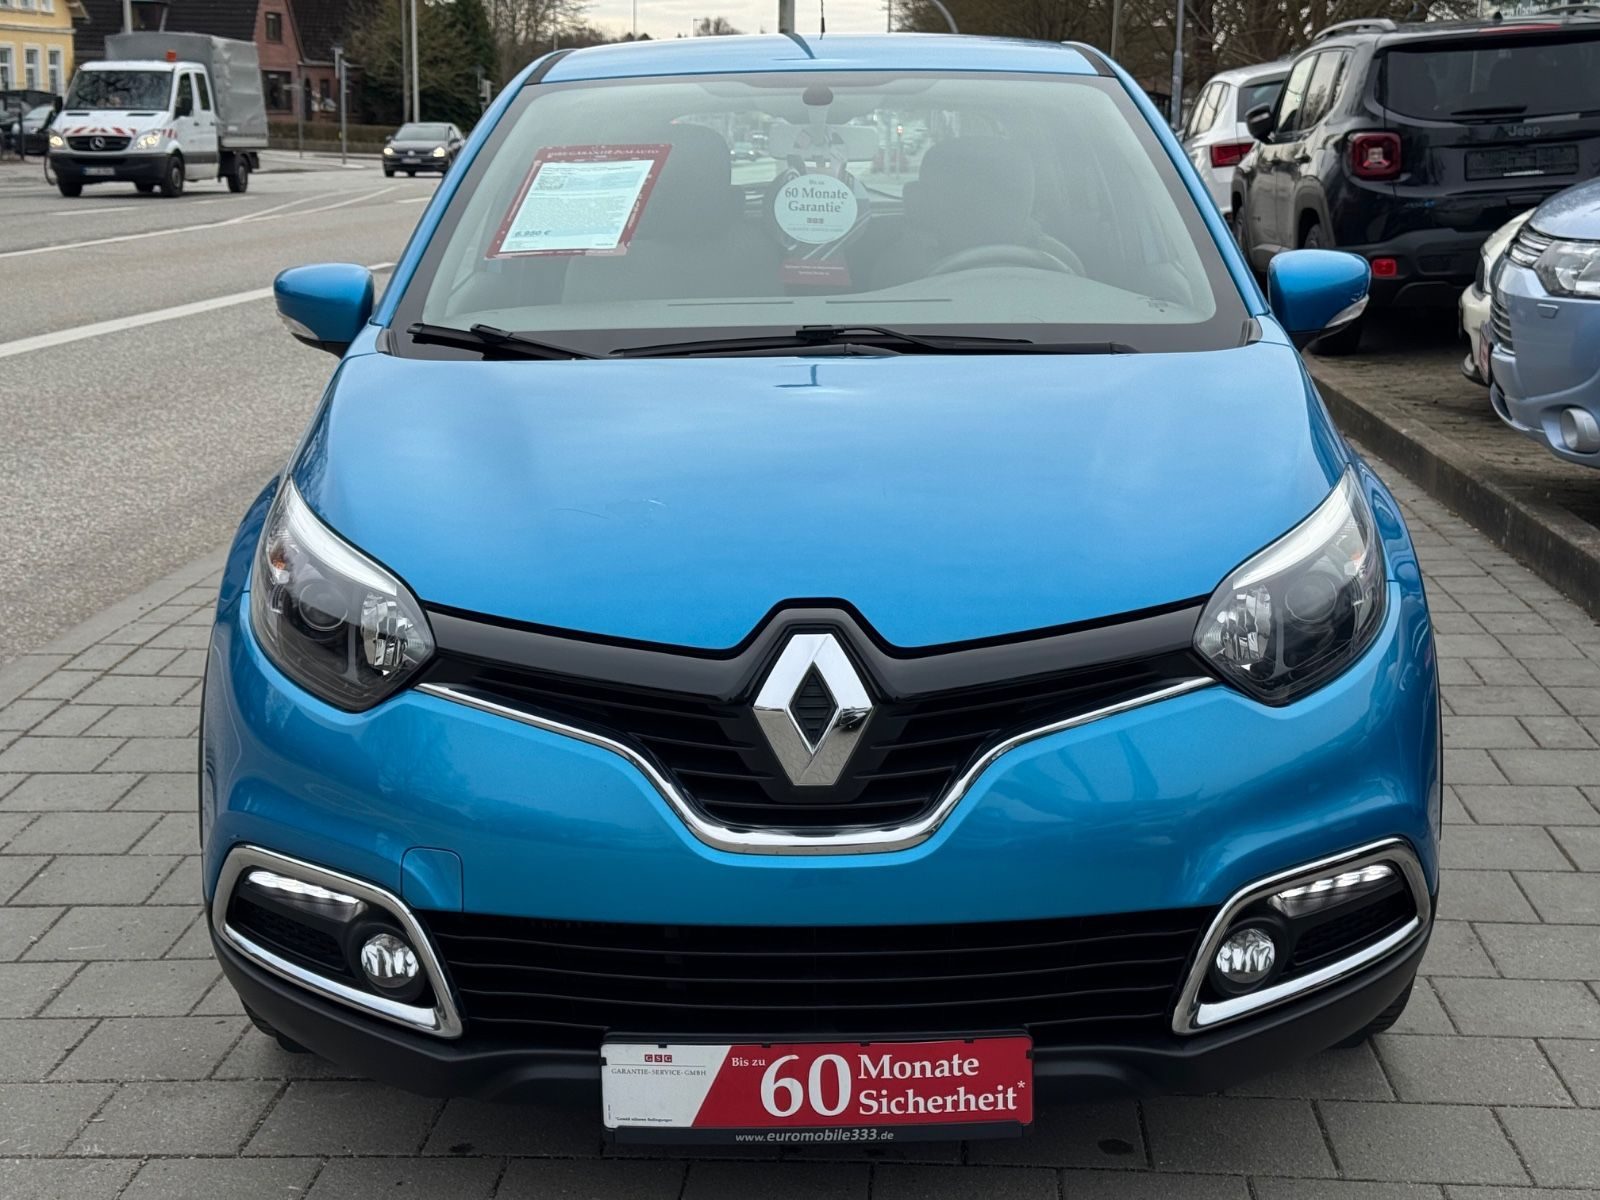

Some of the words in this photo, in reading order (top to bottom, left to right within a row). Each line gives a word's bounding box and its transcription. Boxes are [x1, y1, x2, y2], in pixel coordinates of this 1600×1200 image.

[1508, 125, 1540, 137] Jeep
[785, 187, 798, 198] 60
[802, 187, 849, 199] Monate
[644, 1054, 673, 1063] GSG
[731, 1057, 749, 1067] Bis
[752, 1059, 766, 1067] zu
[857, 1053, 980, 1080] Monate
[761, 1054, 852, 1117] 60
[735, 1129, 894, 1142] www.euromobile333.de
